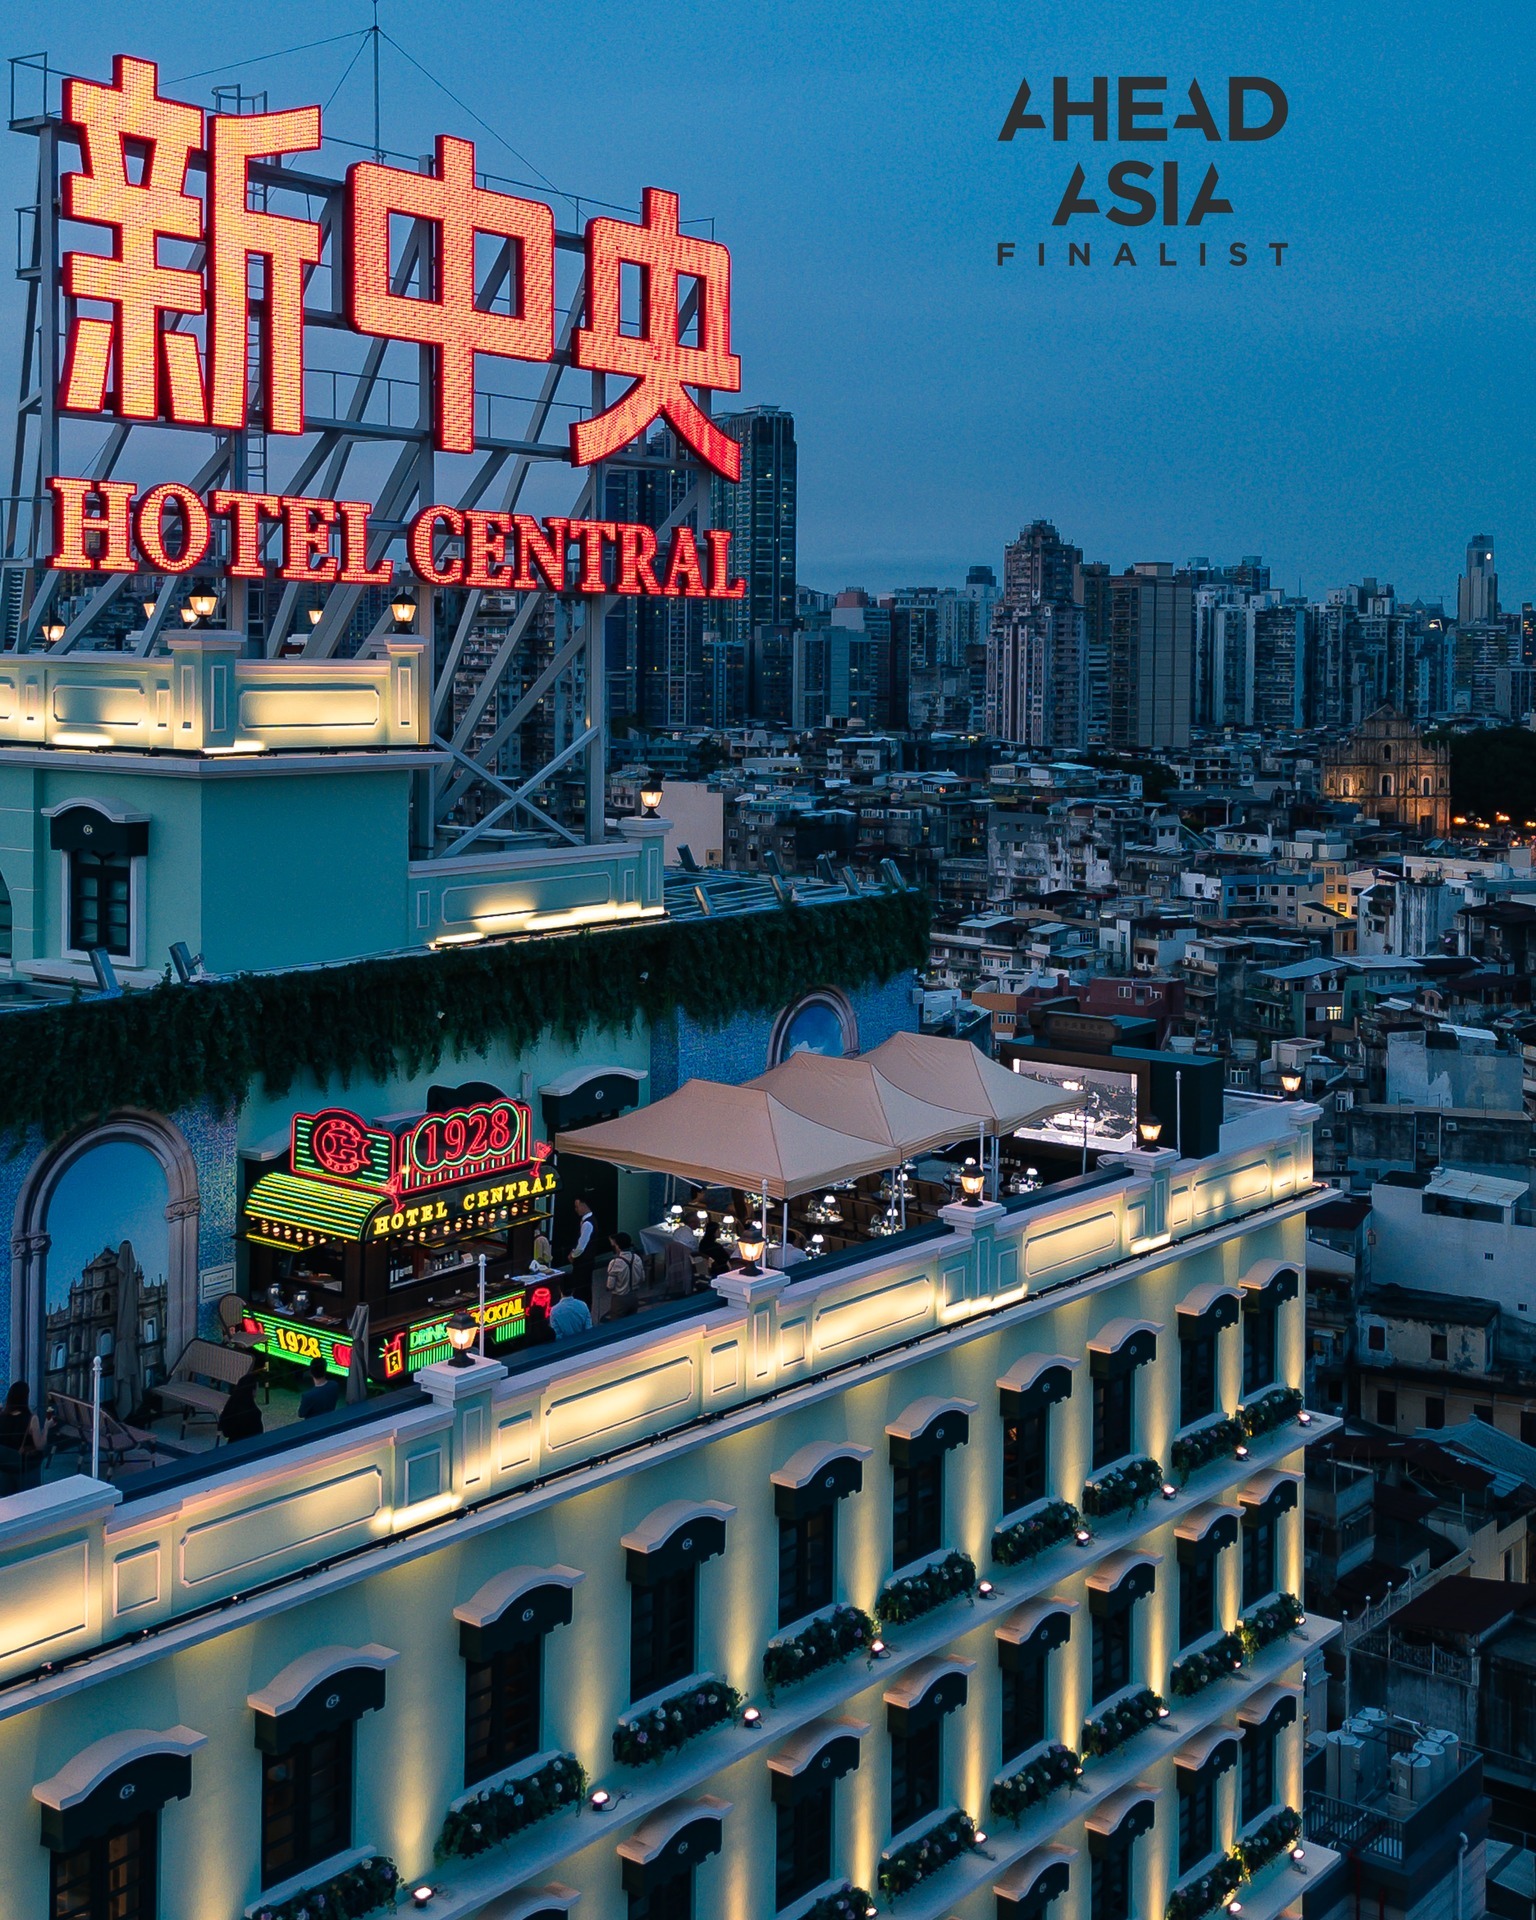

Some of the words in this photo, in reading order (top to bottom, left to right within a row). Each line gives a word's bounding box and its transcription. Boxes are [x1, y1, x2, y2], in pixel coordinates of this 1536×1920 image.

[61, 54, 741, 483] 新中央
[46, 477, 394, 585] HOTEL
[406, 504, 747, 599] CENTRAL
[425, 1109, 511, 1165] 1928
[373, 1201, 448, 1236] HOTEL
[463, 1173, 557, 1211] CENTRAL
[276, 1328, 321, 1358] 1928
